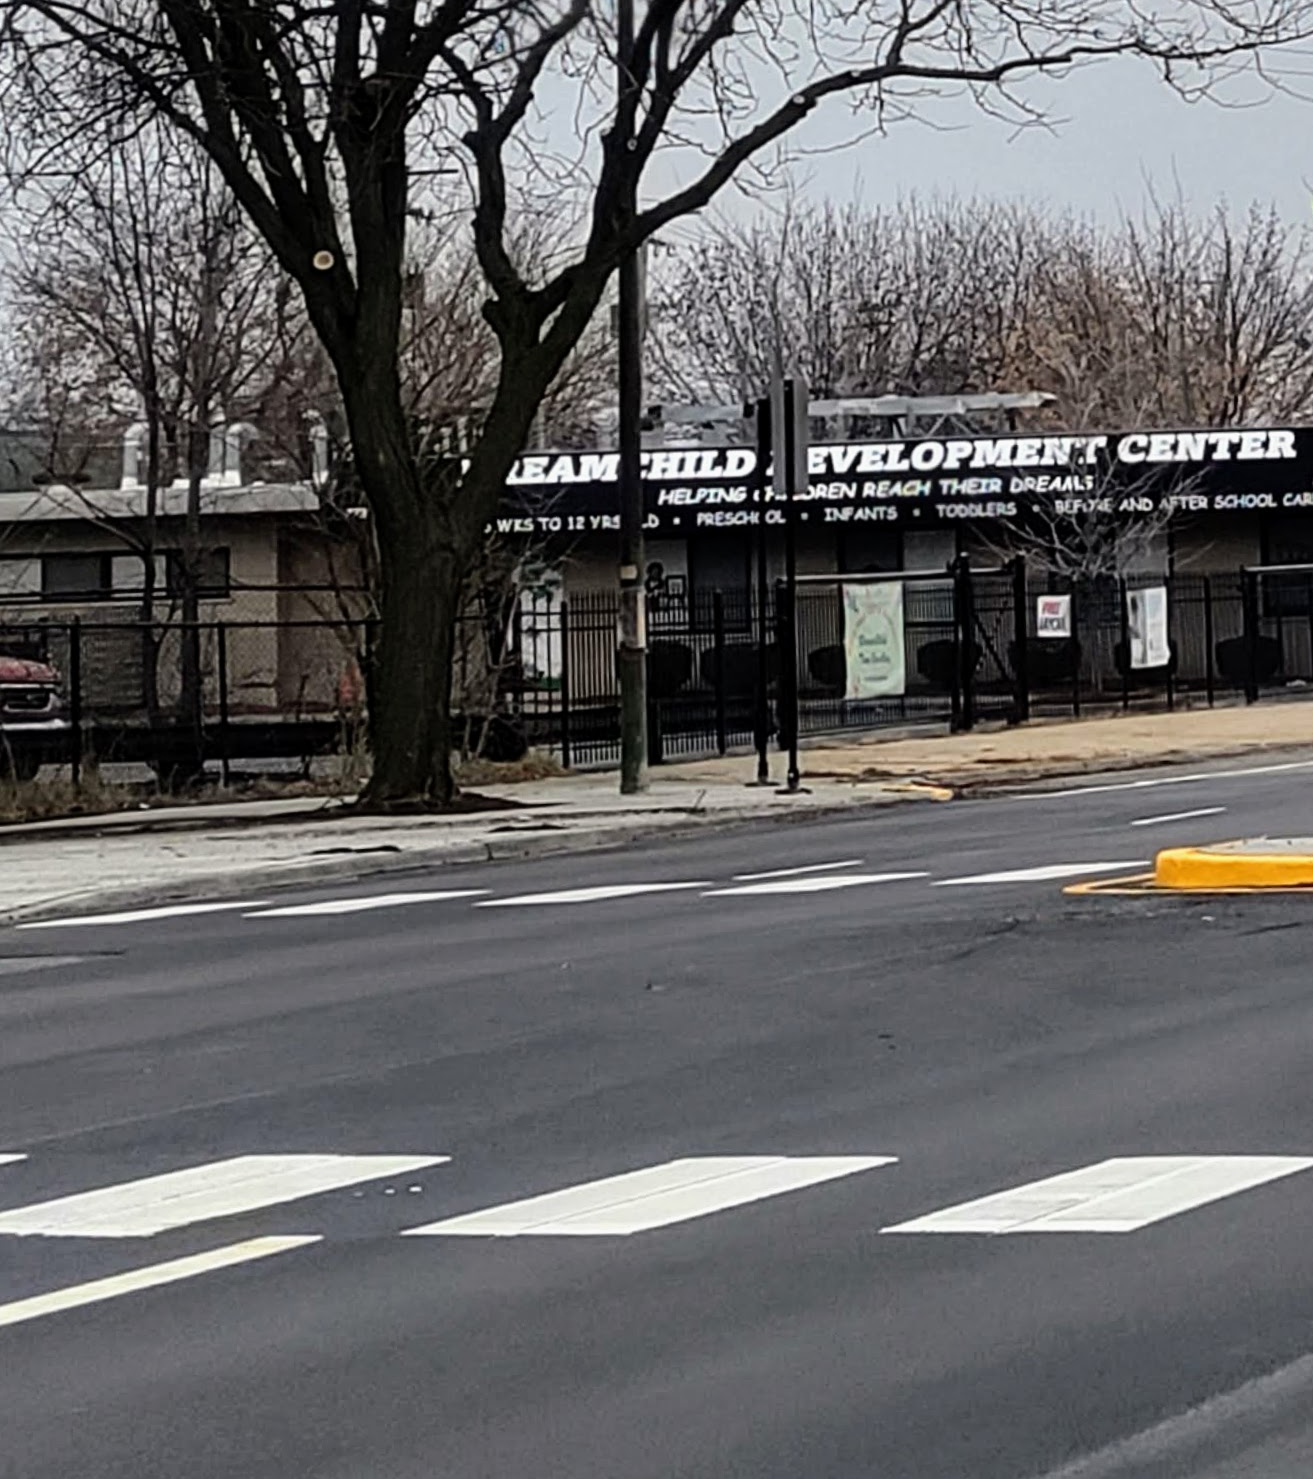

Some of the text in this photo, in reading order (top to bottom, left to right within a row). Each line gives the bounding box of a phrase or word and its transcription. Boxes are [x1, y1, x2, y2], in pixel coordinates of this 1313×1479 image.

[766, 436, 1107, 477] EVELOPMENT
[1117, 430, 1297, 463] CENTER
[658, 486, 748, 506] HELPING
[862, 480, 931, 499] REACH
[939, 477, 1003, 496] THEIR
[936, 502, 1018, 519] TODDLERS
[1119, 495, 1154, 512] AND
[1159, 494, 1209, 511] AFTER
[1214, 492, 1277, 509] SCHOOL
[697, 509, 787, 527] PRESCHOL
[824, 506, 898, 522] INFANTS
[497, 517, 534, 533] WKS
[537, 516, 561, 532] TO
[567, 515, 585, 531] 12
